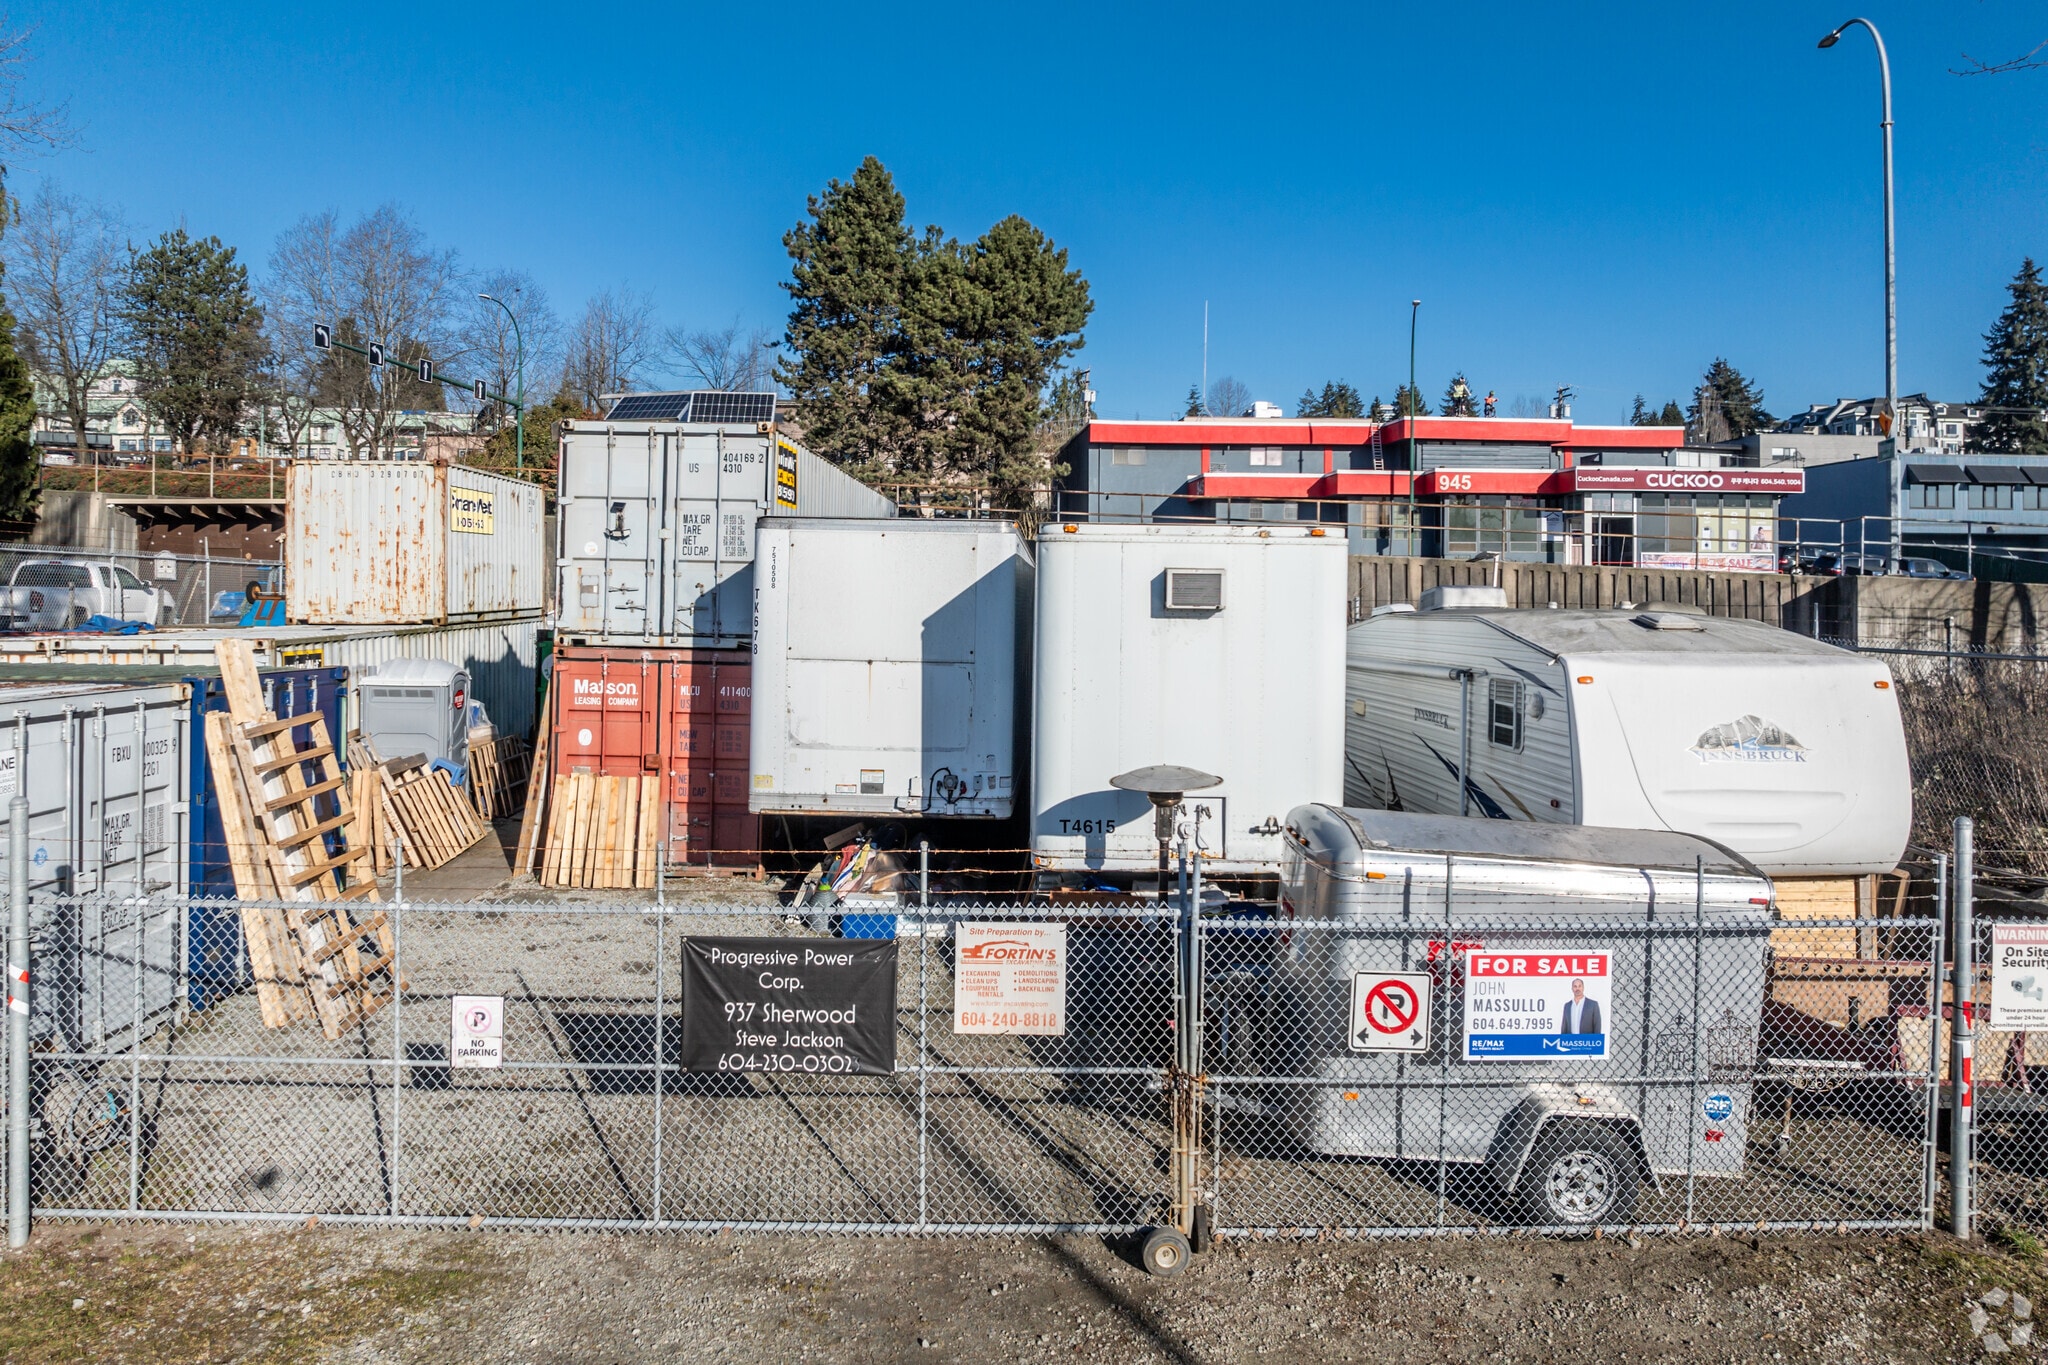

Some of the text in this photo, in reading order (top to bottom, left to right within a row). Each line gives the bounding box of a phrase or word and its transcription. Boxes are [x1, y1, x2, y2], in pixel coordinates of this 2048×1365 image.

[724, 453, 764, 463] 404169 2
[689, 463, 700, 473] US
[723, 464, 742, 473] 4310
[1439, 474, 1472, 491] 945
[1646, 473, 1723, 488] CUCKOO
[683, 525, 701, 534] TARE
[683, 536, 697, 545] NET
[680, 686, 700, 696] MLCU
[680, 700, 690, 709] US
[680, 742, 697, 752] TARE
[112, 745, 131, 763] FBXU
[0, 757, 15, 771] NE
[1059, 819, 1115, 834] T4615
[105, 830, 122, 848] TARE
[105, 847, 117, 864] NET
[986, 928, 1032, 937] Preparation
[712, 948, 854, 968] Progressive Power
[985, 948, 1056, 960] FORTIN'S
[2006, 947, 2023, 957] On
[1477, 958, 1600, 974] FOR SALE
[759, 972, 804, 992] Corp.
[1473, 982, 1505, 995] JOHN
[1473, 999, 1545, 1012] MASSULLO
[724, 1002, 856, 1024] 937 Sherwood
[962, 1012, 1056, 1027] 604-240-8818
[1473, 1018, 1552, 1030] 604.649.7995
[735, 1030, 844, 1048] Steve Jackson
